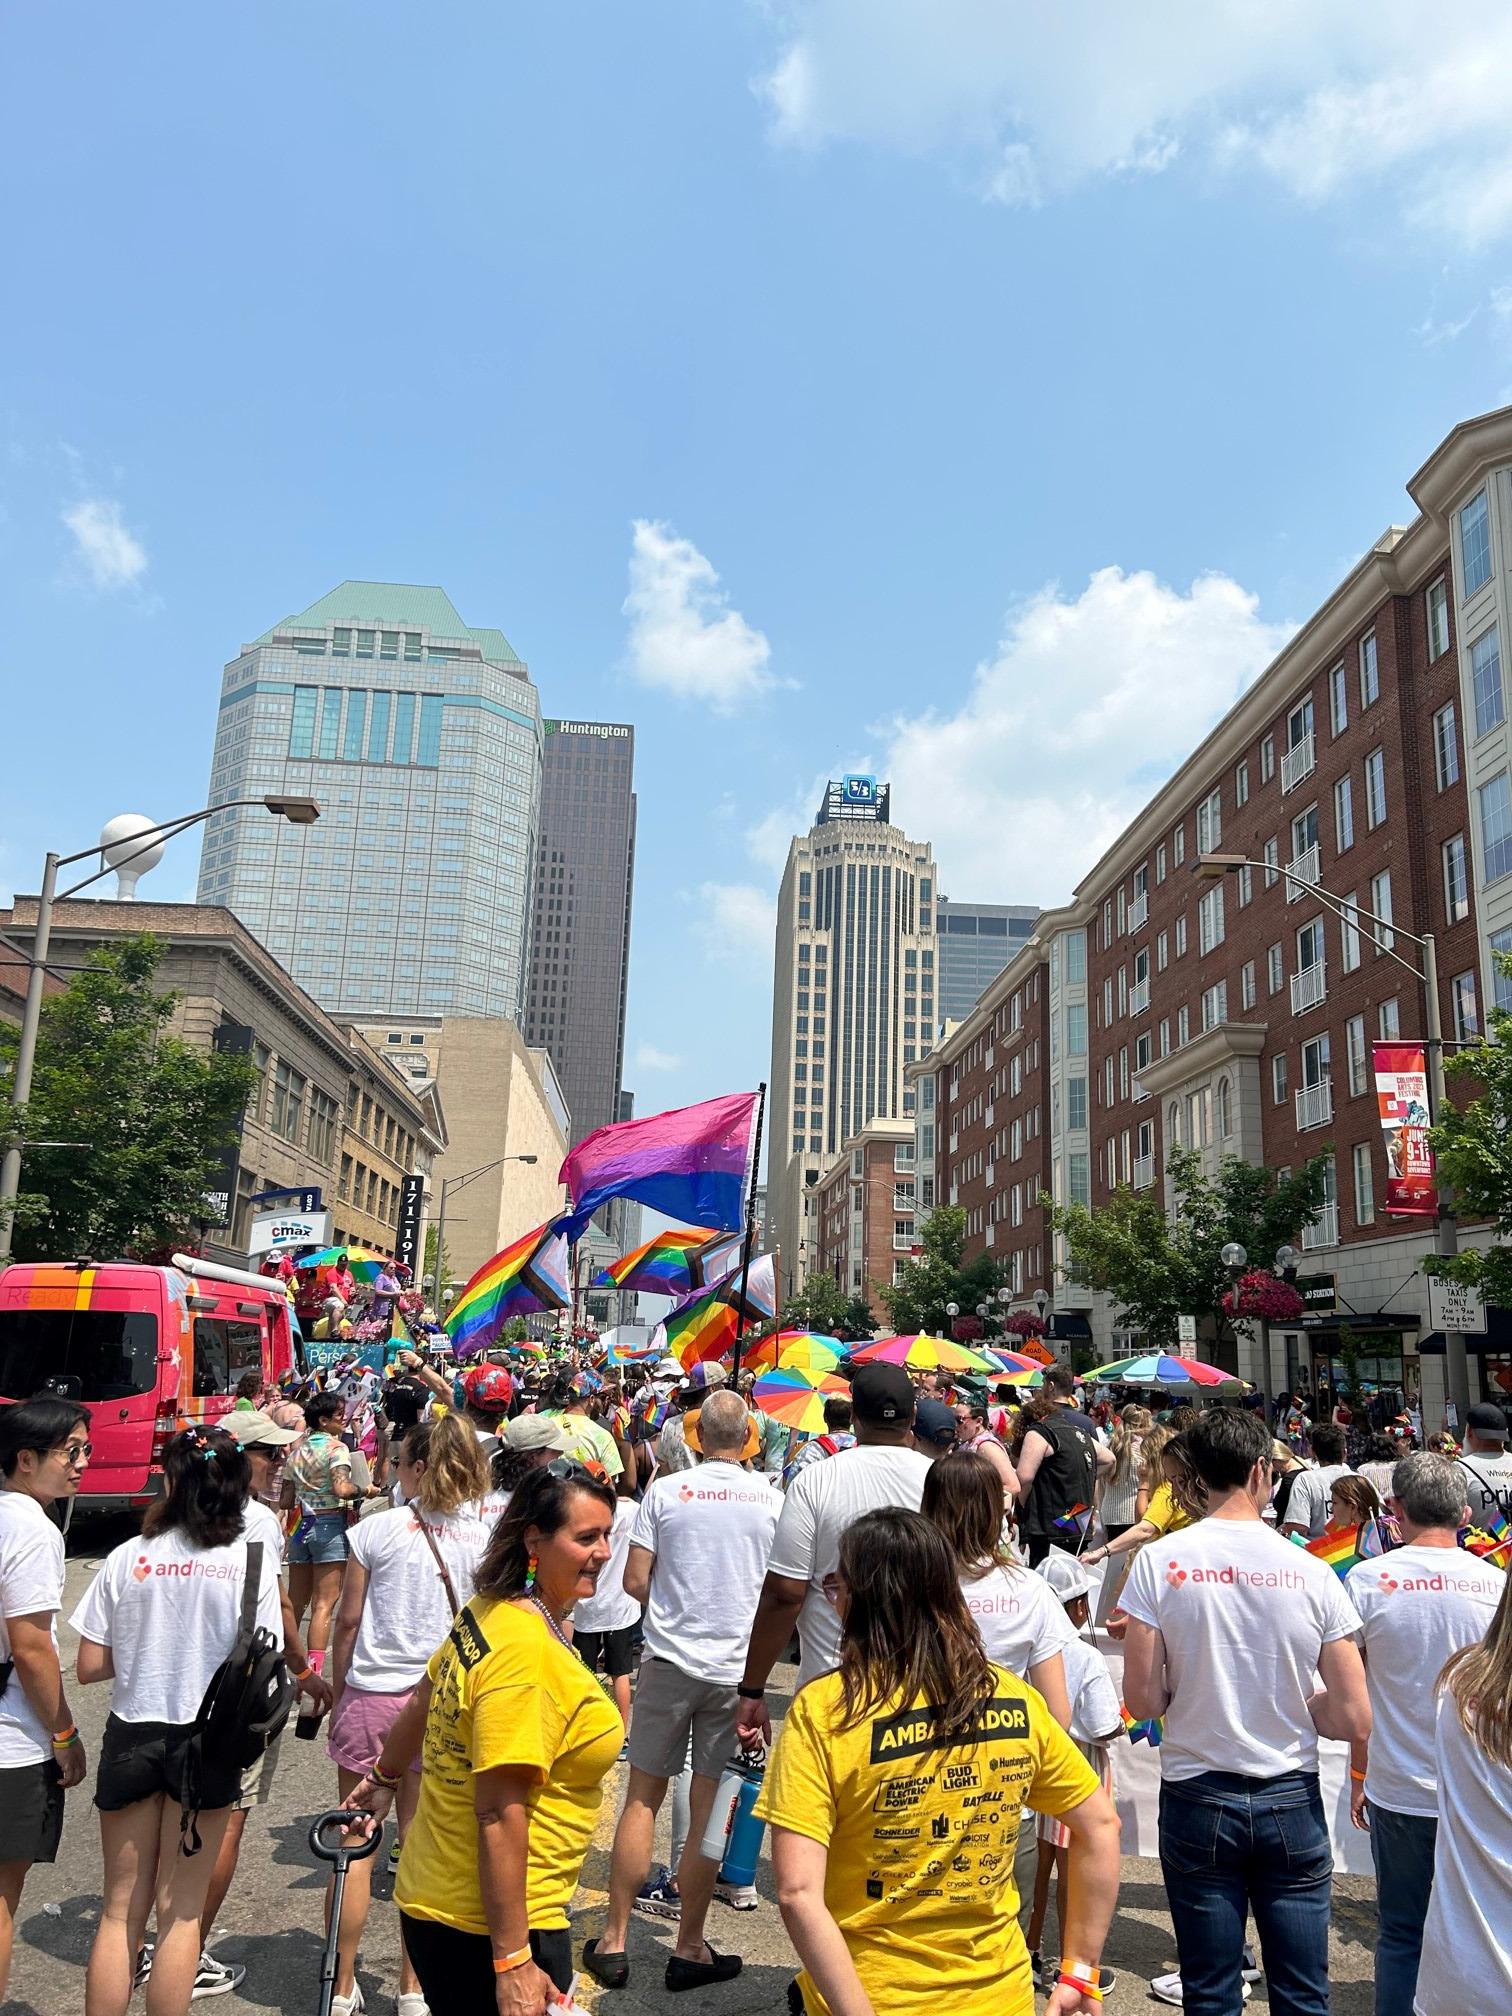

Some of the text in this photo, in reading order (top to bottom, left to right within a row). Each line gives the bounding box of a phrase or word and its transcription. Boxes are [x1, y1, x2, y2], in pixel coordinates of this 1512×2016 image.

[560, 721, 628, 739] Huntington
[402, 1181, 417, 1264] 171-191
[272, 1226, 311, 1237] cmax
[1447, 1289, 1468, 1297] TAXIS
[1448, 1298, 1467, 1306] ONLY
[697, 1489, 773, 1506] andhealth
[1192, 1566, 1305, 1590] andhealth
[999, 1756, 1032, 1768] Huntington
[947, 1766, 972, 1778] BUD
[1001, 1770, 1033, 1782] HONDA
[888, 1775, 936, 1790] AMERICAN
[943, 1775, 978, 1790] LIGHT
[886, 1786, 926, 1799] ELECTRIC
[885, 1797, 919, 1807] POWER
[979, 1853, 1003, 1871] Kroger
